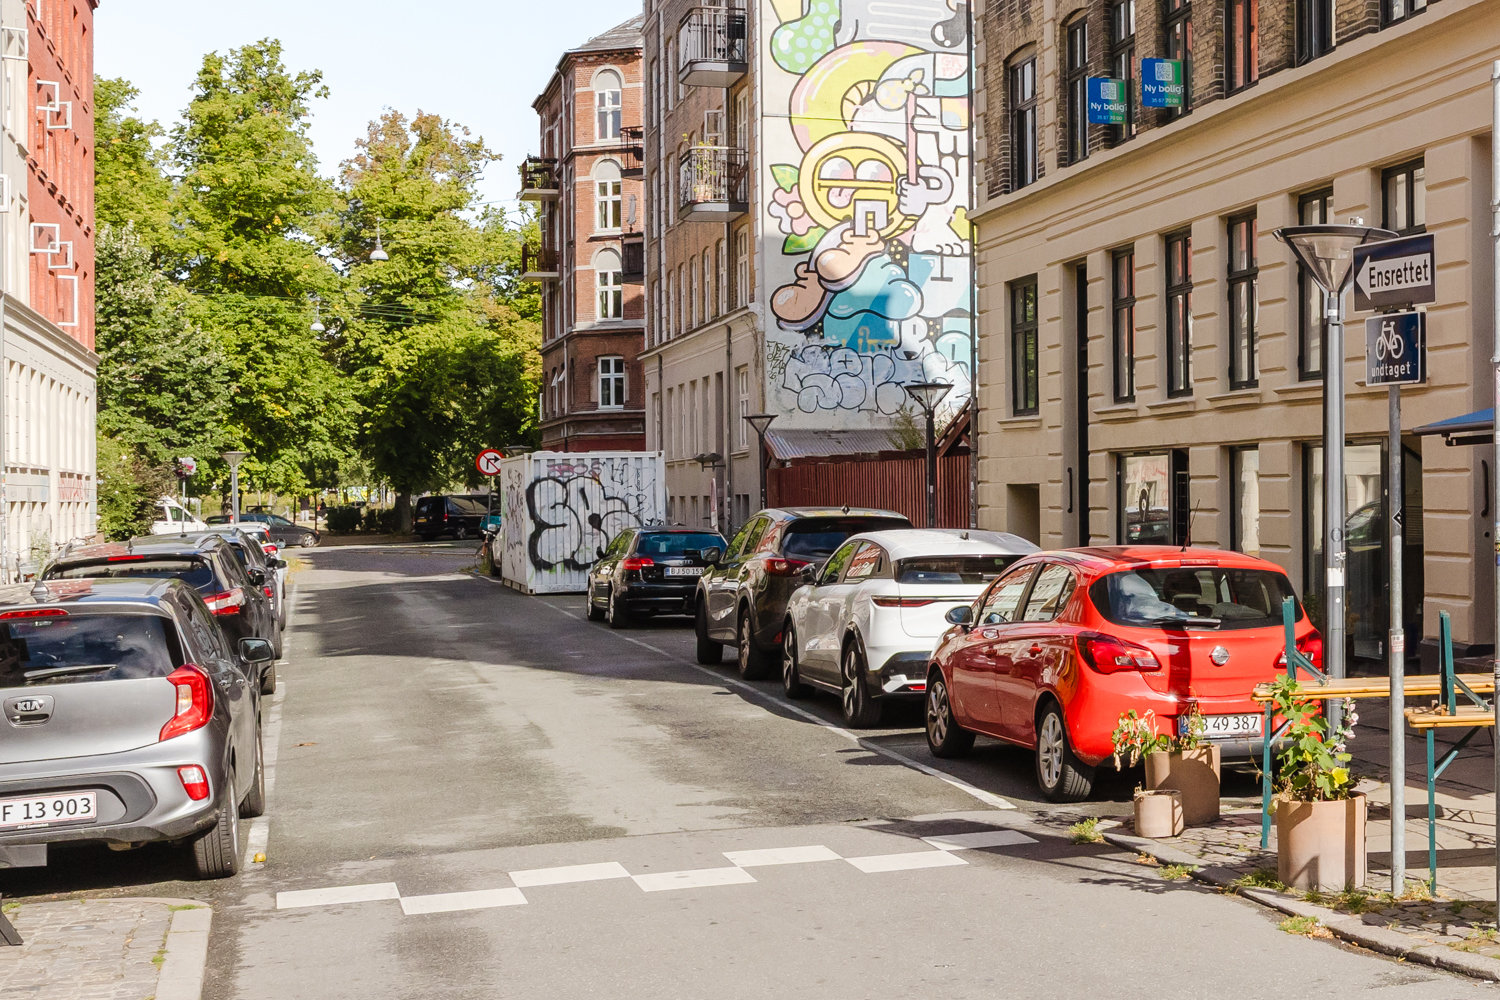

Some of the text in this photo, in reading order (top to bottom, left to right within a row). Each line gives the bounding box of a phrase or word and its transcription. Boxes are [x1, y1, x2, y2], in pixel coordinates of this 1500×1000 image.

[1144, 84, 1156, 94] Ny
[1090, 102, 1101, 112] Ny
[1369, 259, 1429, 289] Ensrettet
[1371, 361, 1411, 378] undtaget
[670, 567, 704, 575] BJ 50 153
[17, 700, 40, 711] KIA
[1213, 716, 1229, 731] 49
[1233, 716, 1258, 731] 387
[23, 802, 46, 820] 13
[52, 797, 91, 817] 903
